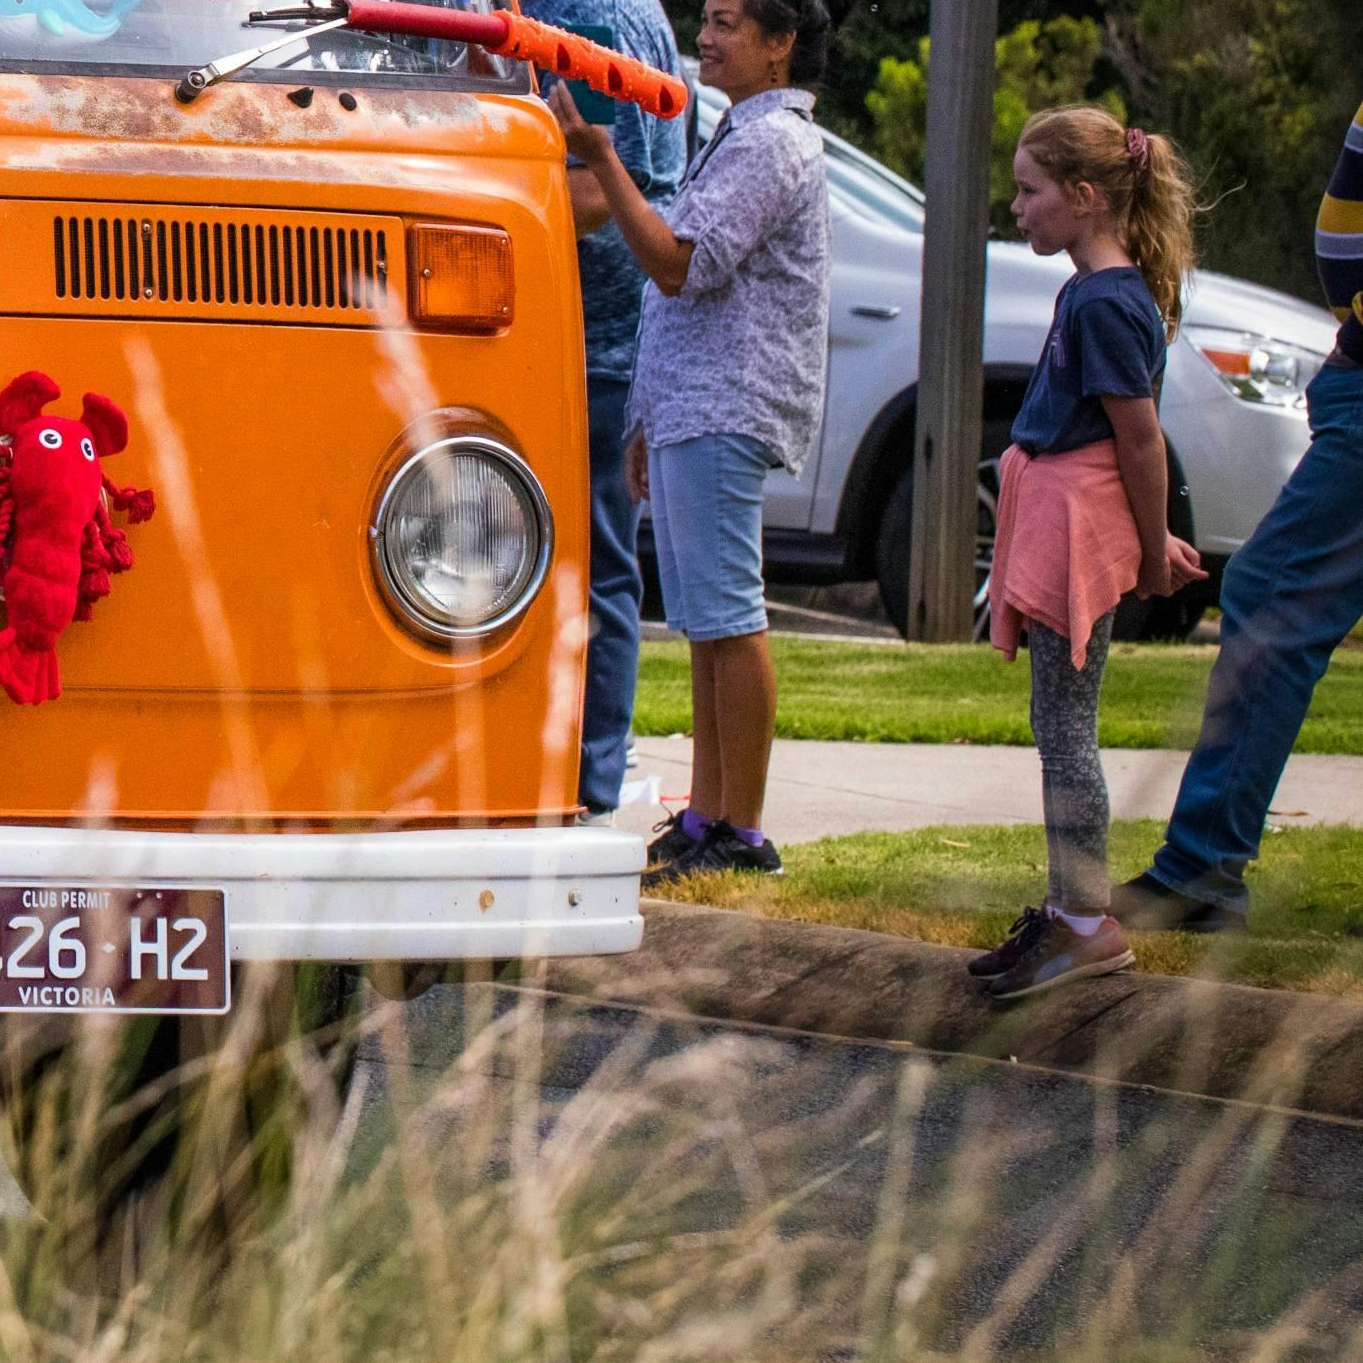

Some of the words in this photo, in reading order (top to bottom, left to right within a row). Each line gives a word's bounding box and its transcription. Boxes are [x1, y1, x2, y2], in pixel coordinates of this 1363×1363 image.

[22, 890, 57, 908] CLUB
[61, 891, 111, 909] PERMIT
[130, 917, 209, 981] H2
[18, 985, 116, 1006] VICTORIA
